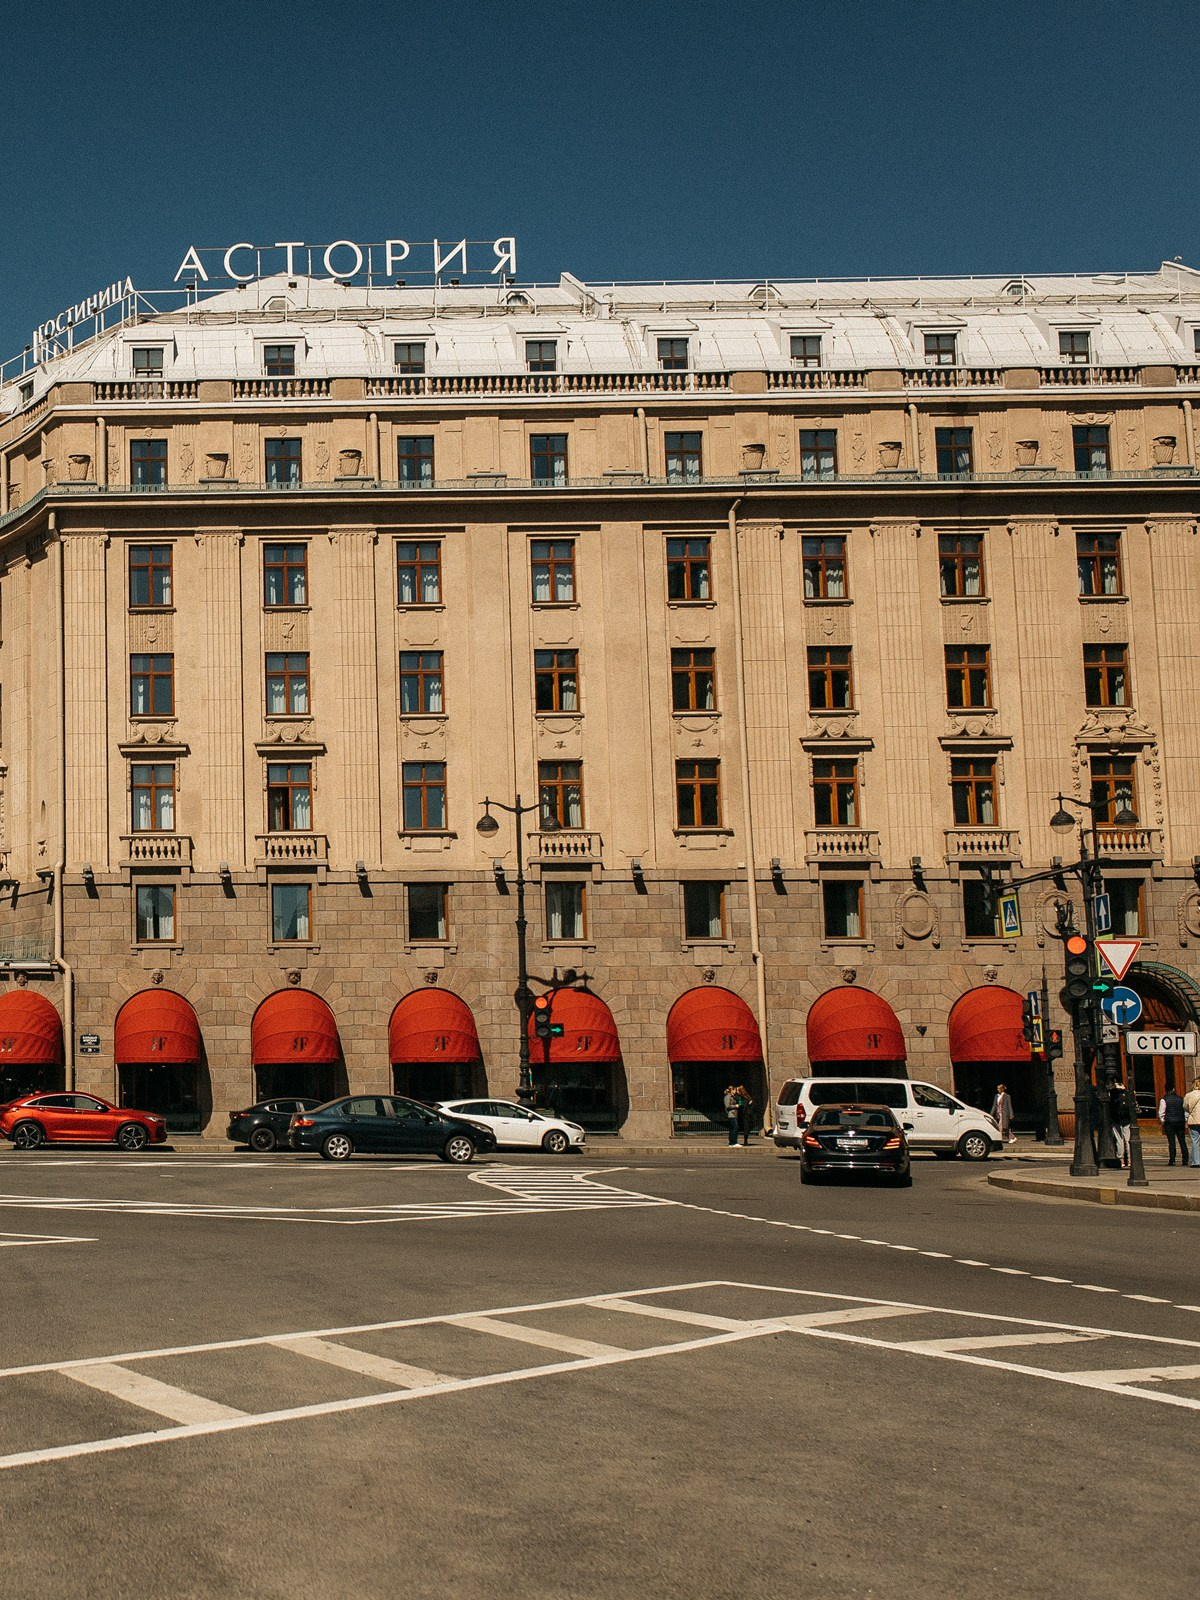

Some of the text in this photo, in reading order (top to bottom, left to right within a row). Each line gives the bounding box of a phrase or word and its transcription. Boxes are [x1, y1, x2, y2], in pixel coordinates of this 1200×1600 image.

[174, 237, 517, 282] АСТОРИЯ
[38, 275, 136, 344] ГОСТИНИЦА
[1137, 1036, 1186, 1050] СТОП
